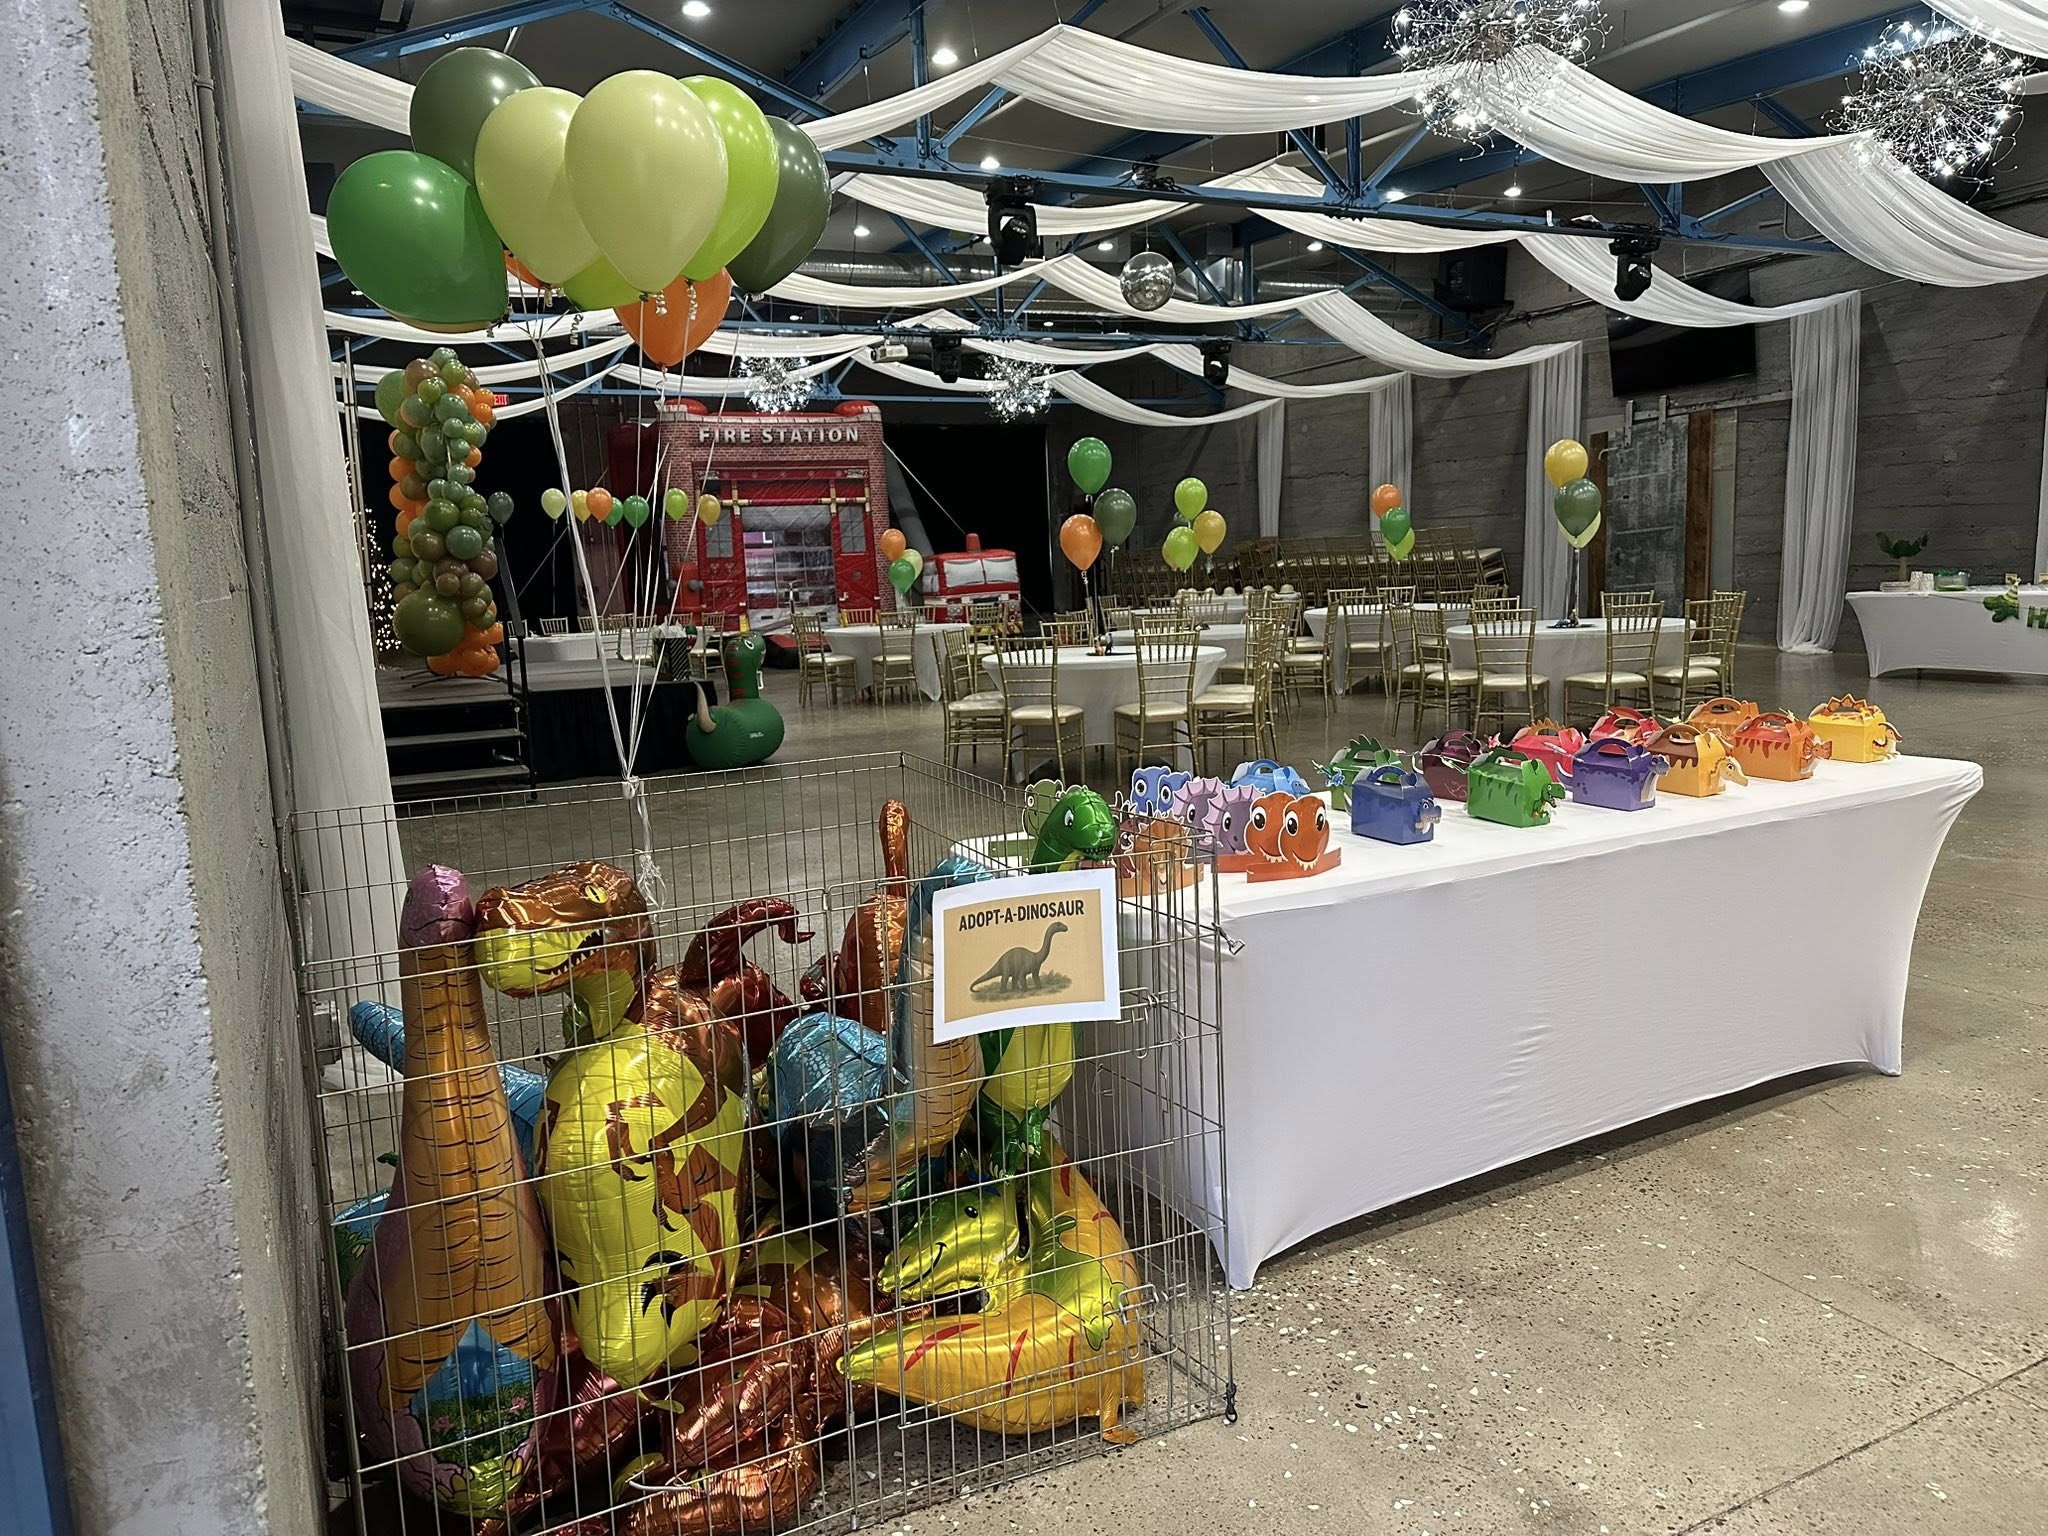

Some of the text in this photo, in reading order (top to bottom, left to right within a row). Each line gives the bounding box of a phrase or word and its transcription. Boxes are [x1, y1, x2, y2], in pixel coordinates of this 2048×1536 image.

[699, 427, 859, 444] FIRE STATION
[2026, 605, 2048, 630] H
[958, 899, 1085, 932] ADOPT-A-DINOSAUR
